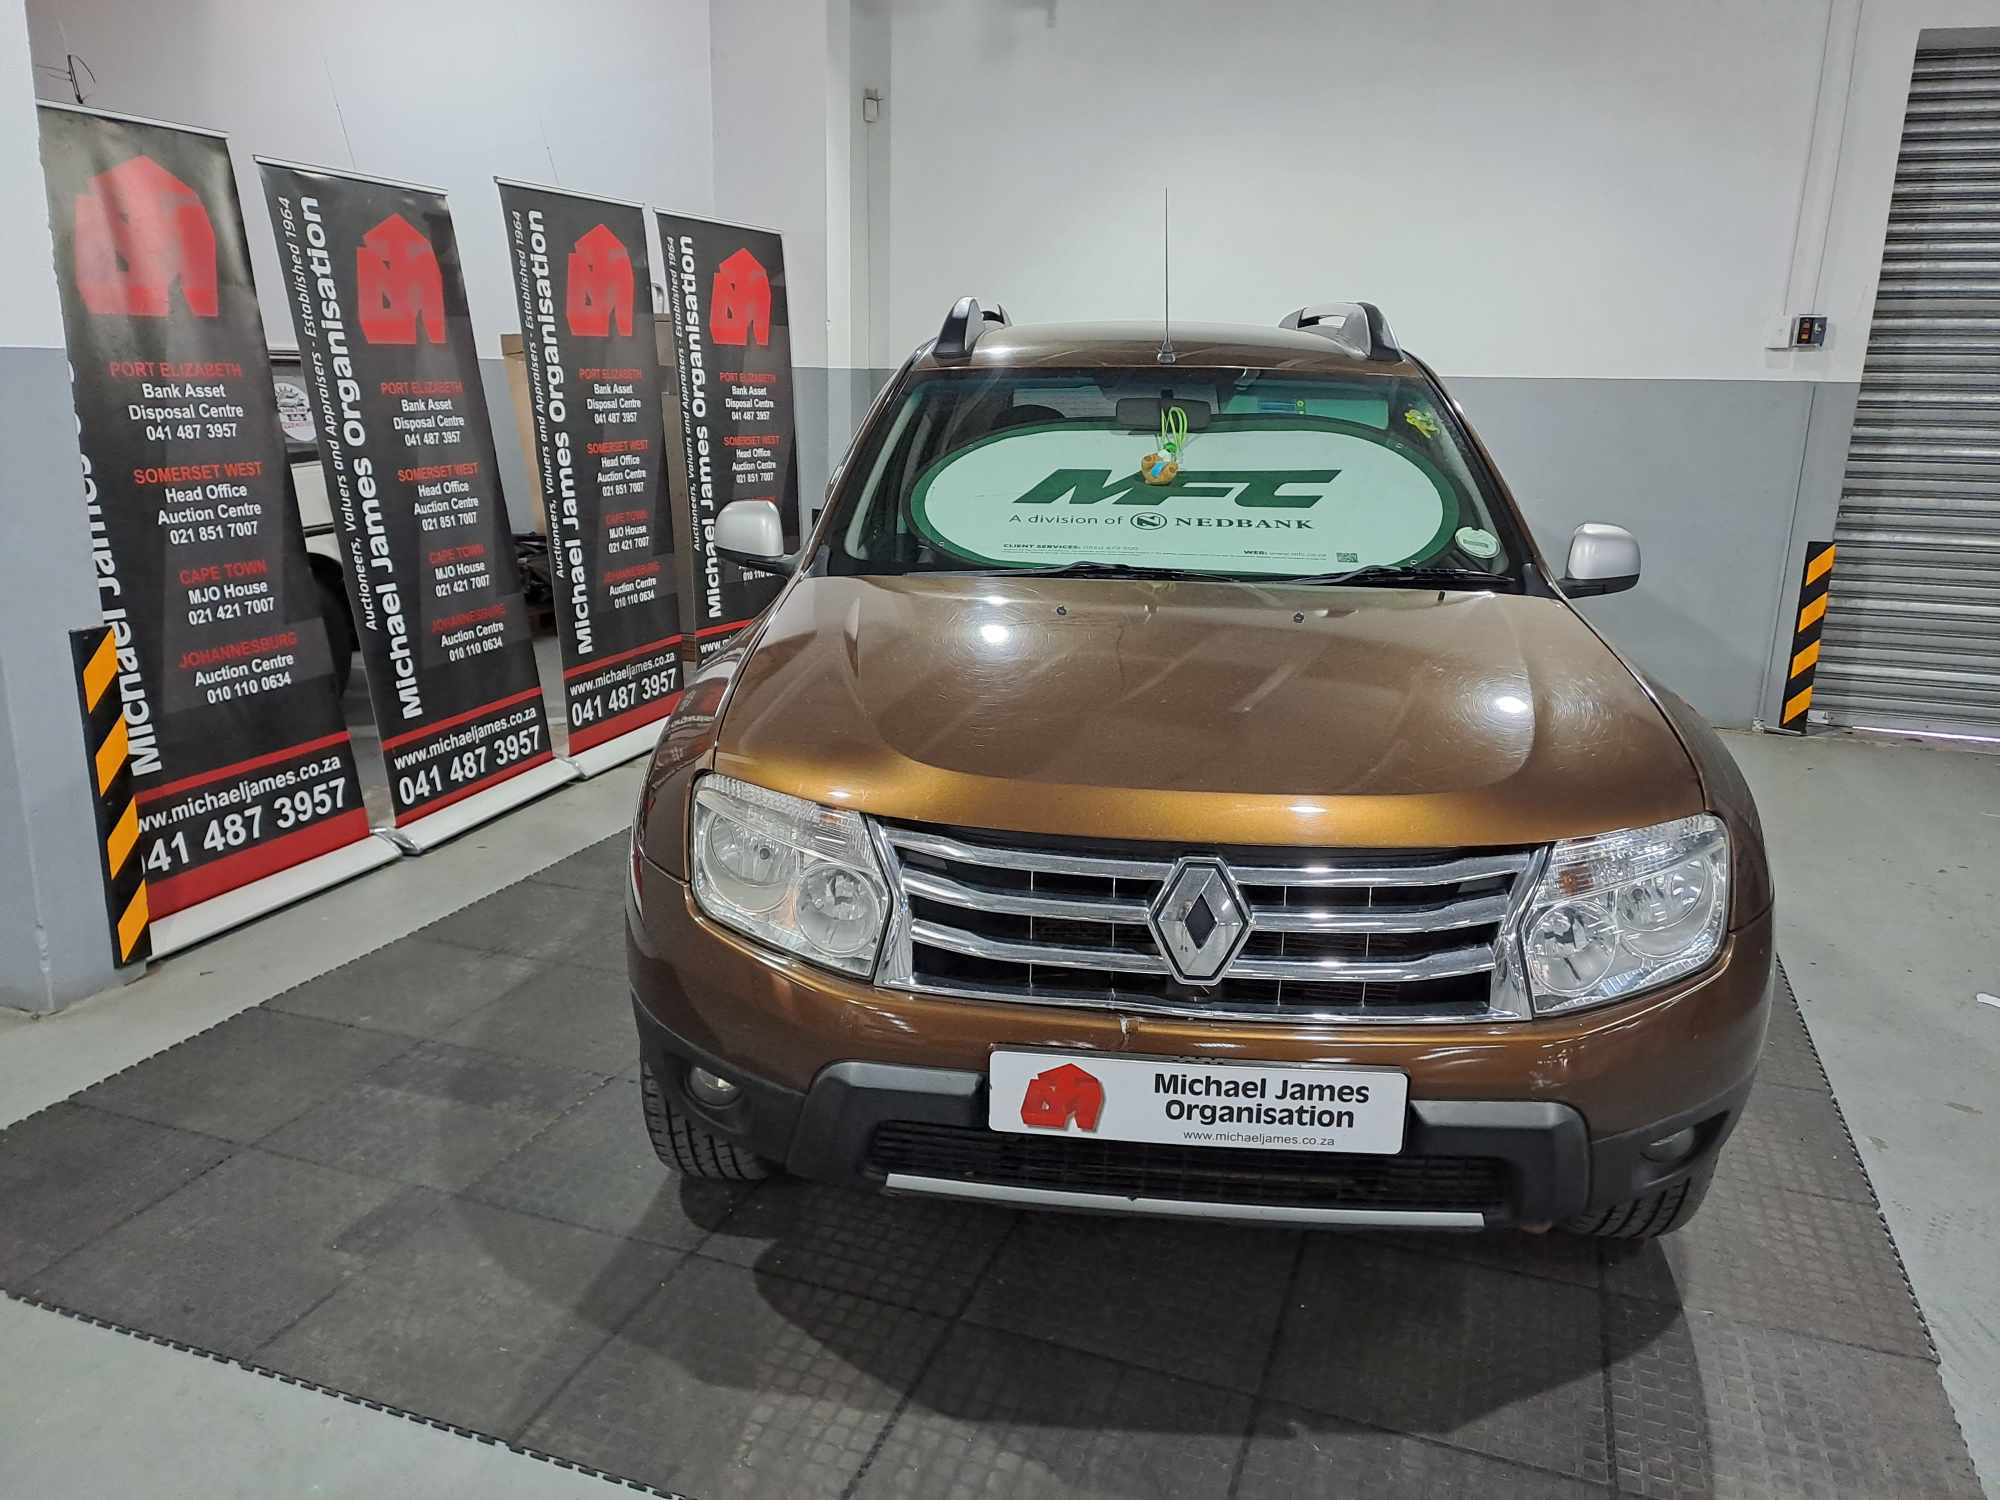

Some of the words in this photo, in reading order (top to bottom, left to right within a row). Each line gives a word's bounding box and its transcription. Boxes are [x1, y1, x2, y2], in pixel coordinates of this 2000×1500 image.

[278, 196, 297, 239] 1964
[512, 211, 524, 245] 1964
[286, 243, 317, 337] Established
[518, 249, 534, 330] Established
[300, 196, 366, 447] Organisation
[528, 210, 566, 423] Organisation
[680, 235, 706, 418] Organisation
[109, 362, 155, 377] PORT
[160, 362, 242, 378] ELIZABETH
[528, 341, 544, 414] Appraisers
[142, 383, 182, 399] Bank
[184, 383, 227, 398] Asset
[311, 351, 338, 438] Appraisers
[381, 382, 409, 395] PORT
[594, 384, 612, 395] Bank
[613, 383, 633, 394] Asset
[732, 385, 748, 396] Bank
[128, 404, 195, 423] Disposal
[199, 403, 244, 418] Centre
[401, 399, 426, 412] Bank
[428, 398, 453, 411] Asset
[586, 398, 618, 411] Disposal
[619, 398, 641, 409] Centre
[725, 398, 752, 410] Disposal
[754, 398, 774, 408] Centre
[393, 415, 435, 431] Disposal
[437, 414, 465, 427] Centre
[536, 415, 548, 442] and
[594, 413, 606, 424] 041
[607, 412, 620, 423] 487
[622, 412, 637, 422] 3957
[146, 425, 172, 441] 041
[176, 424, 201, 440] 487
[206, 423, 237, 438] 3957
[405, 434, 421, 446] 041
[423, 432, 439, 444] 487
[442, 431, 461, 443] 3957
[327, 441, 345, 471] and
[601, 456, 619, 468] Head
[620, 454, 640, 465] Office
[696, 426, 713, 511] James
[732, 462, 755, 472] Auction
[757, 460, 776, 470] Centre
[134, 464, 220, 485] SOMERSET
[223, 461, 263, 477] WEST
[398, 465, 452, 481] SOMERSET
[542, 444, 553, 495] Valuers
[555, 432, 580, 531] James
[597, 471, 623, 483] Auction
[624, 469, 646, 480] Centre
[165, 486, 203, 503] Head
[206, 484, 248, 500] Office
[418, 483, 441, 497] Head
[443, 480, 469, 494] Office
[602, 485, 614, 497] 021
[629, 482, 644, 493] 7007
[1012, 469, 1342, 508] MFC
[158, 508, 214, 525] Auction
[218, 502, 262, 518] Centre
[337, 474, 356, 532] Valuers
[354, 457, 393, 574] James
[414, 500, 449, 515] Auction
[451, 497, 479, 510] Centre
[170, 528, 196, 545] 021
[199, 525, 224, 541] 851
[227, 521, 258, 538] 7007
[422, 517, 439, 531] 021
[440, 515, 456, 528] 851
[457, 512, 477, 525] 7007
[609, 527, 624, 539] MJO
[624, 525, 647, 536] House
[1009, 514, 1021, 523] A
[1028, 513, 1097, 525] division
[1105, 514, 1124, 525] of
[1175, 517, 1314, 529] NEDBANK
[550, 499, 565, 578] Auctioneers,
[608, 542, 620, 553] 021
[621, 539, 632, 550] 421
[634, 536, 649, 548] 7007
[179, 566, 221, 584] CAPE
[224, 560, 268, 578] TOWN
[435, 565, 456, 580] MJO
[456, 562, 485, 575] House
[702, 517, 722, 618] Michael
[188, 586, 221, 605] MJO
[223, 582, 268, 599] House
[351, 537, 378, 631] Auctioneers,
[435, 584, 452, 597] 021
[453, 579, 468, 593] 421
[470, 574, 490, 589] 7007
[609, 582, 634, 596] Auction
[635, 577, 657, 589] Centre
[565, 539, 593, 655] Michael
[627, 594, 638, 605] 110
[188, 607, 213, 625] 021
[216, 603, 241, 620] 421
[244, 597, 275, 615] 7007
[441, 630, 475, 647] Auction
[476, 621, 504, 637] Centre
[178, 632, 297, 669] JOHANNESBURG
[375, 582, 423, 720] Michael
[449, 647, 465, 662] 010
[466, 642, 481, 657] 110
[483, 636, 503, 652] 0634
[195, 663, 249, 687] Auction
[252, 654, 294, 673] Centre
[570, 652, 675, 696] www.michaeljames.co.za
[207, 686, 232, 704] 010
[234, 679, 259, 697] 110
[261, 671, 292, 691] 0634
[572, 695, 602, 726] 041
[608, 682, 636, 711] 487
[641, 668, 676, 700] 3957
[394, 707, 537, 770] www.michaeljames.co.za
[399, 764, 443, 805] 041
[450, 746, 487, 782] 487
[493, 725, 540, 766] 3957
[141, 831, 190, 876] 41
[203, 805, 263, 852] 487
[274, 777, 346, 828] 3957
[1154, 1072, 1266, 1100] Michael
[1275, 1079, 1370, 1103] James
[1164, 1099, 1355, 1129] Organisation
[1183, 1130, 1335, 1147] www.michaeljames.co.za
